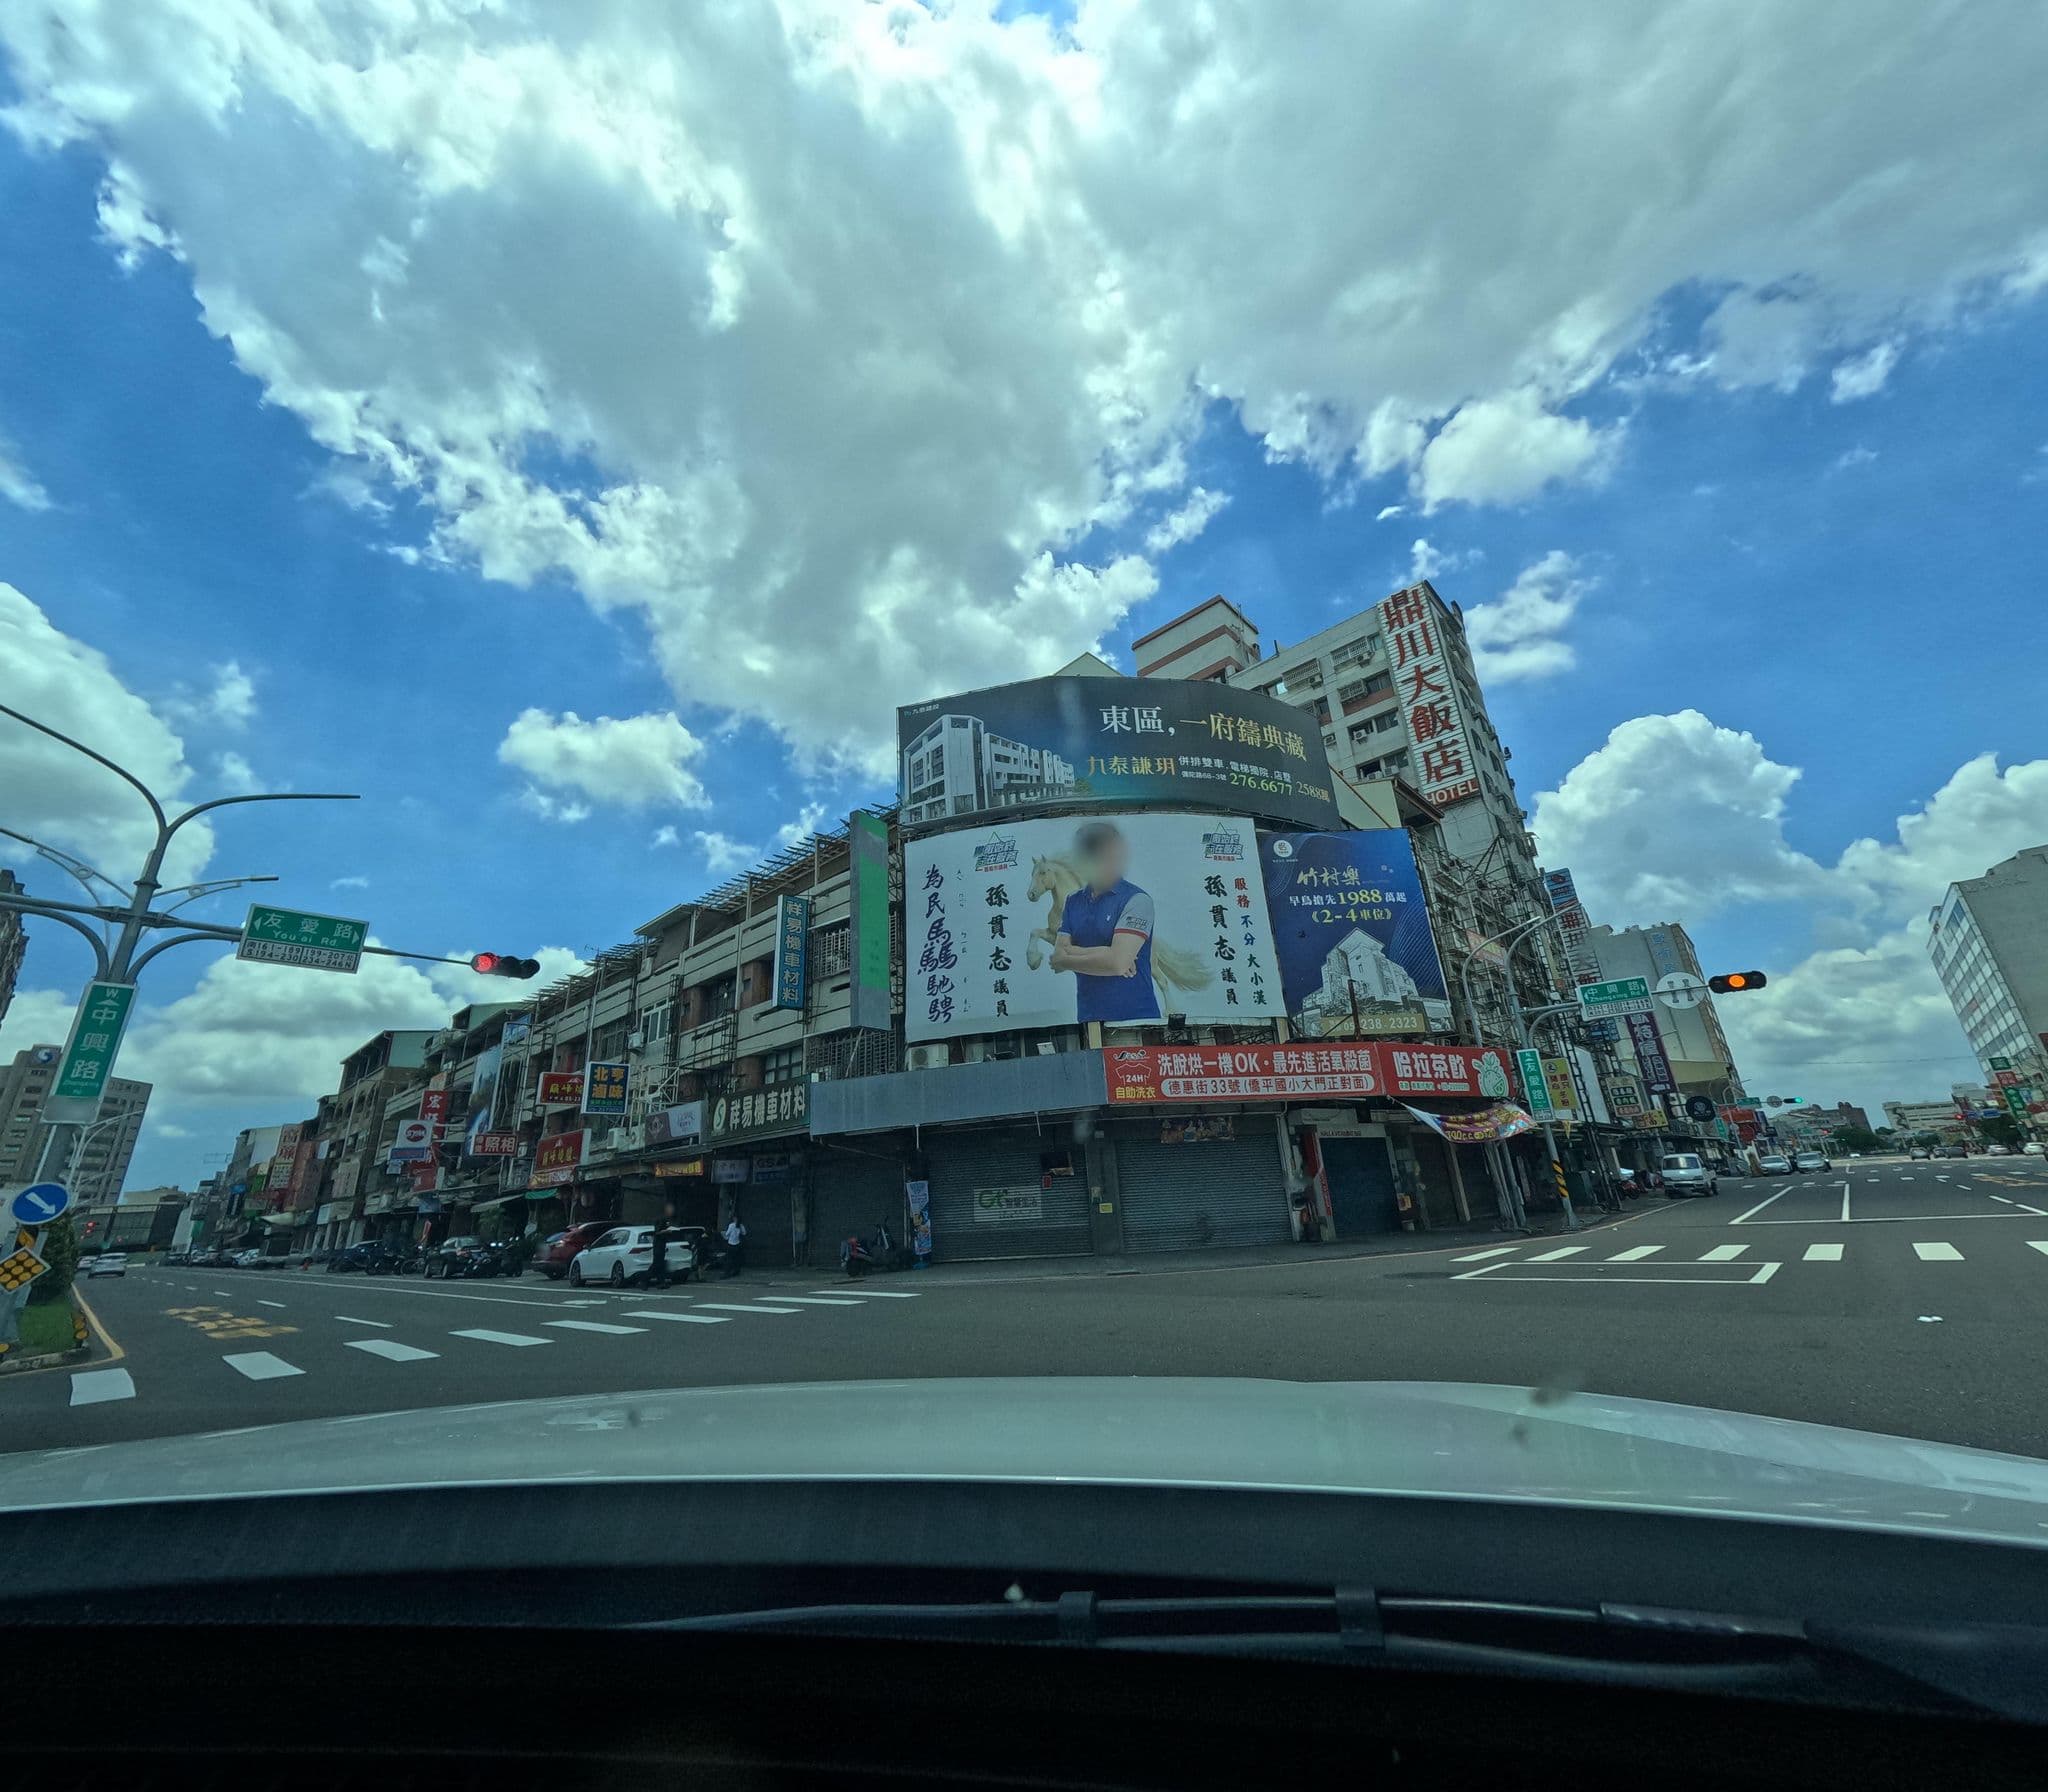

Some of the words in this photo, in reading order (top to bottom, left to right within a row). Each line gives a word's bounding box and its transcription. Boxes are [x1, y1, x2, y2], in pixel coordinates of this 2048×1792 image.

[1383, 588, 1464, 783] 鼎川大飯店
[1088, 755, 1175, 777] 九泰謙玥
[1230, 773, 1293, 795] 276.6677
[1426, 779, 1478, 805] HOTEL
[264, 912, 352, 938] 友愛路
[782, 901, 803, 1003] 祥易機車材料
[985, 884, 1012, 1018] 孫貫志議員
[1204, 875, 1239, 1005] 孫貫志議員
[1234, 877, 1267, 1005] 服務不分大小漢
[1587, 981, 1640, 996] 中興路
[70, 1007, 117, 1079] 中興路
[1126, 1074, 1143, 1083] 24H
[1392, 1051, 1468, 1079] 哈拉茶飲
[1115, 1087, 1156, 1099] 自助洗衣
[1525, 1063, 1544, 1099] 友愛路
[729, 1085, 806, 1131] 祥易機車材料
[485, 1136, 515, 1152] 照相
